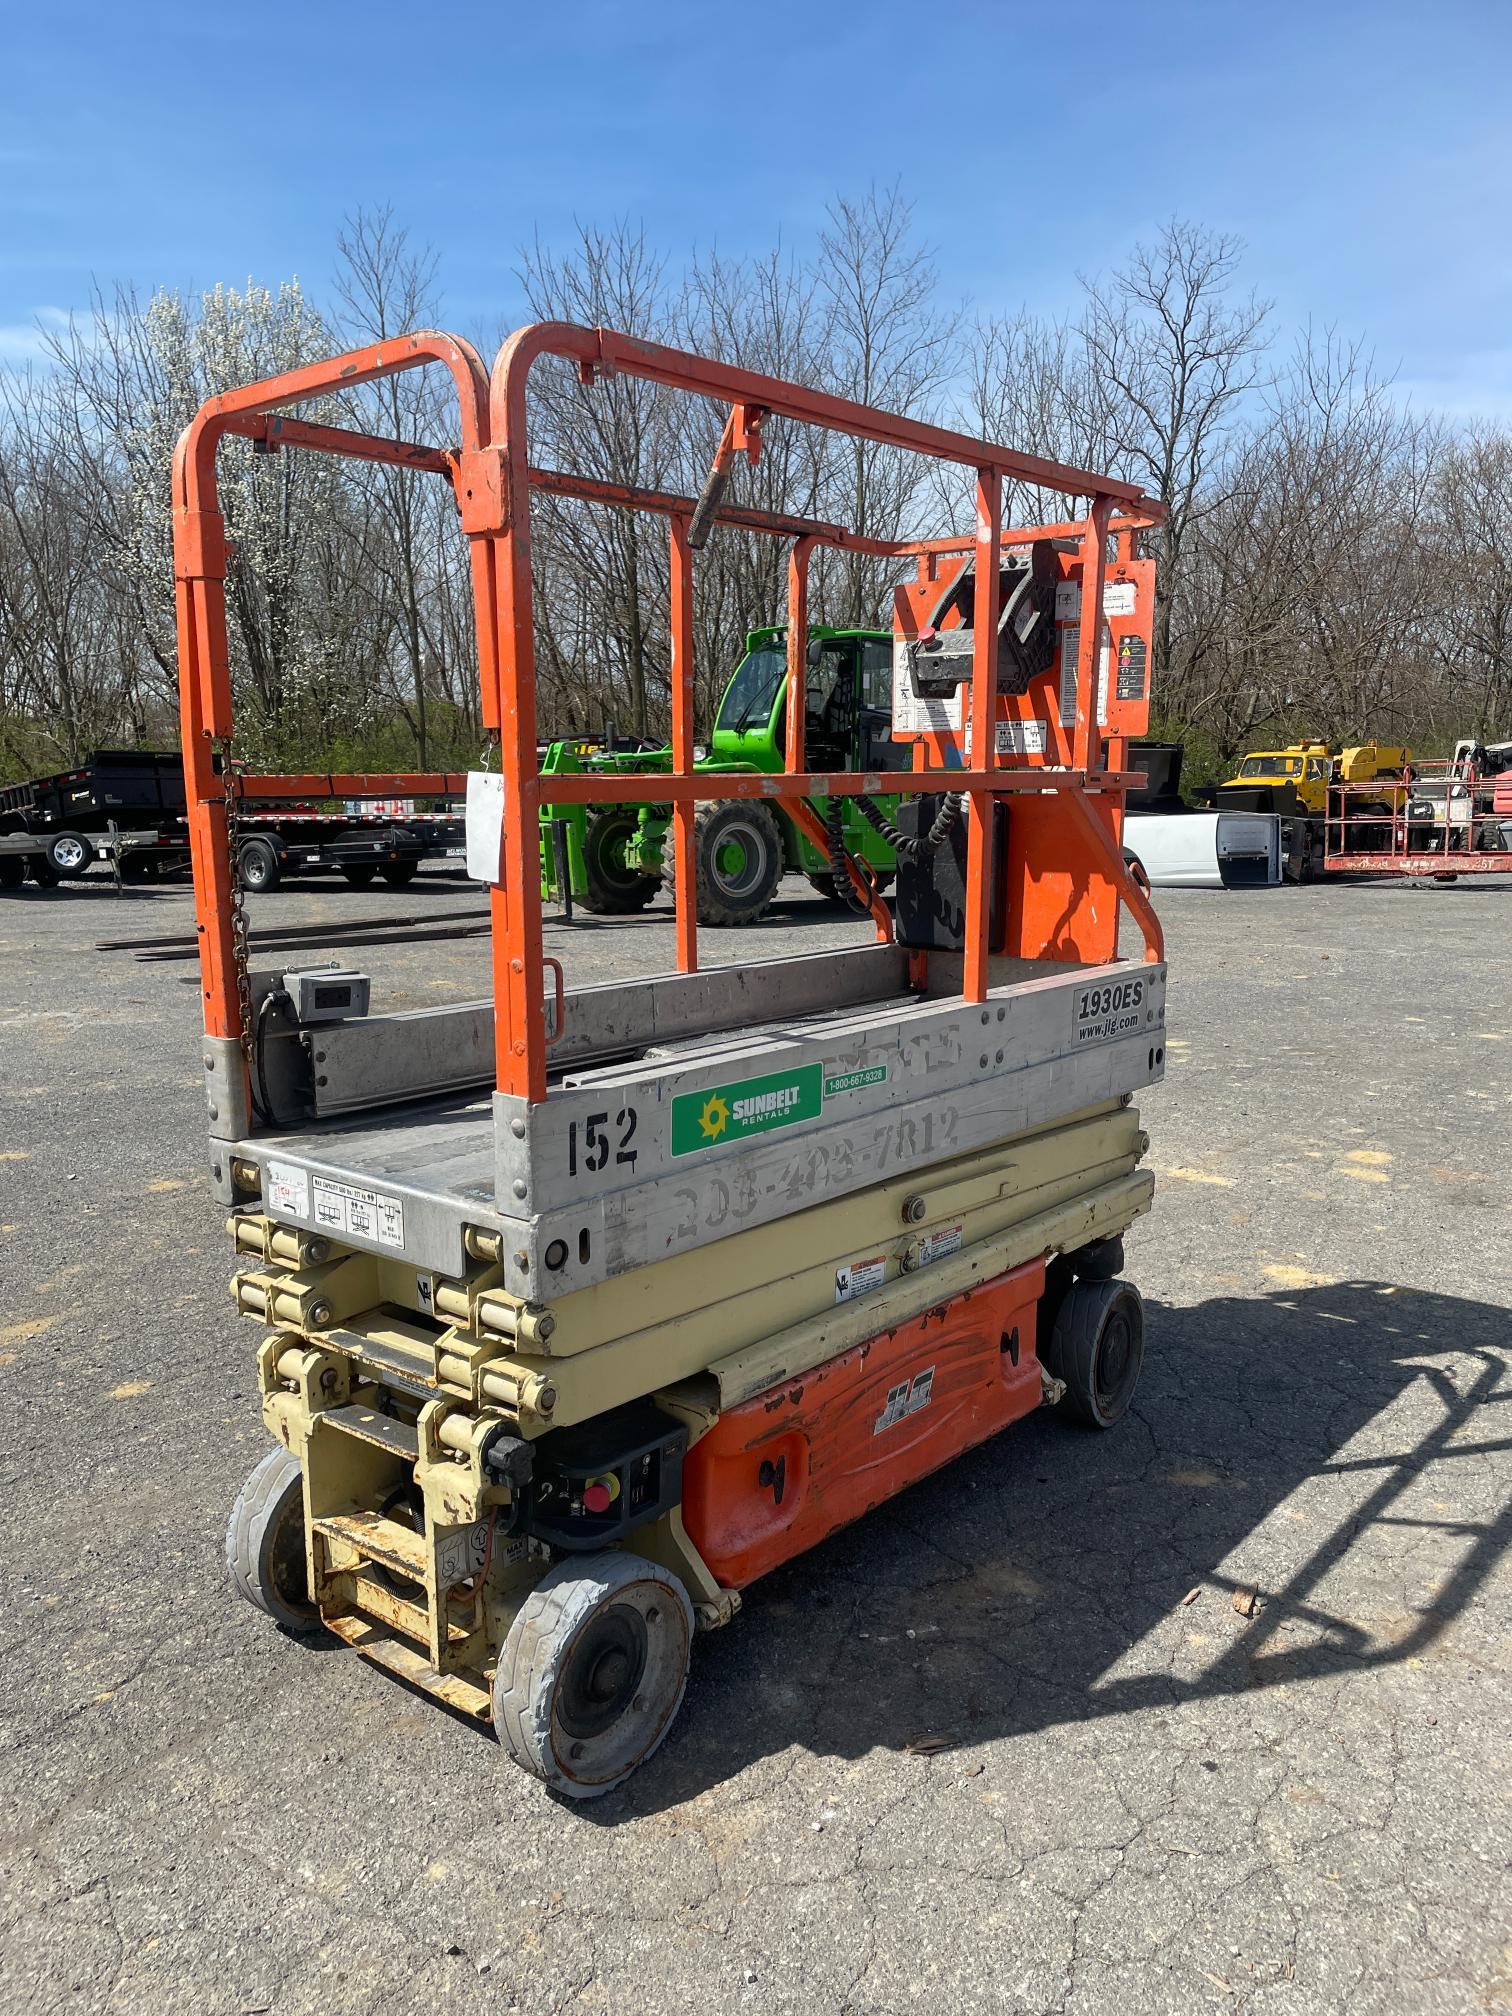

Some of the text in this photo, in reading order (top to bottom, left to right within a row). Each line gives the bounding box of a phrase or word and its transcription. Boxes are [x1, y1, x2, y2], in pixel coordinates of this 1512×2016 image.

[1400, 748, 1406, 766] 4
[1079, 981, 1143, 1020] 1930ES
[1079, 1014, 1138, 1040] www.jlg.com
[829, 1069, 883, 1091] 1-800-667-9328
[732, 1085, 800, 1121] SUNBELT
[742, 1107, 790, 1127] RENTALS
[569, 1107, 637, 1176] 152
[507, 1541, 523, 1555] MAX
